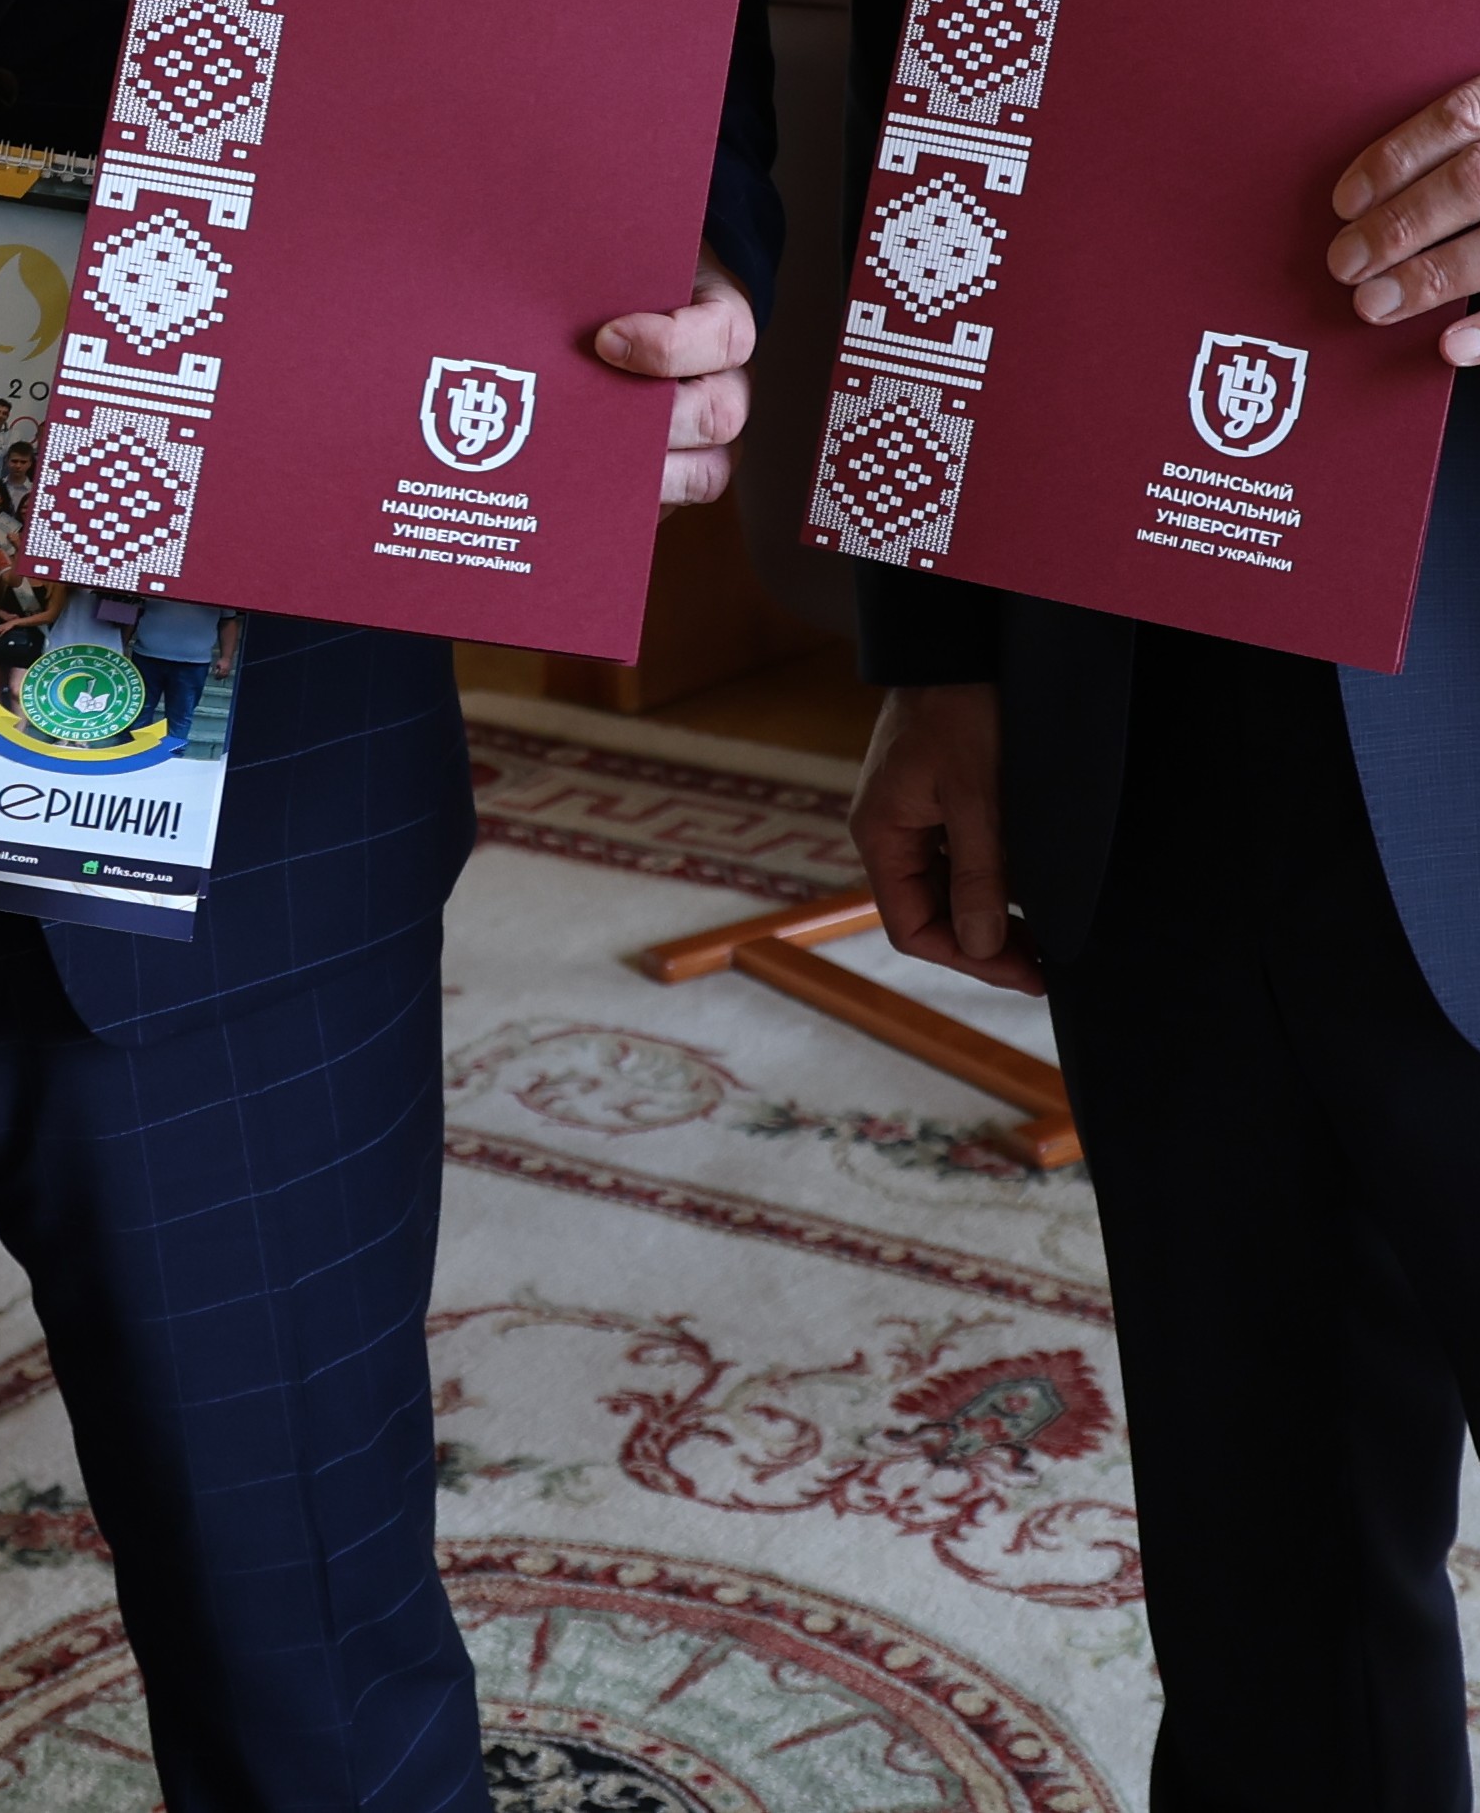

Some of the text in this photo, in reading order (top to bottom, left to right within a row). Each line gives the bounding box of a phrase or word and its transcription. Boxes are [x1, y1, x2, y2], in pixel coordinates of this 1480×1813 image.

[8, 378, 50, 402] 20
[397, 479, 529, 509] ВОЛИНСЬКИЙ
[1162, 462, 1294, 501] ВОЛИНСЬКИЙ
[381, 499, 537, 533] НАЦІОНАЛЬНИЙ
[1146, 483, 1301, 528] НАЦІОНАЛЬНИЙ
[392, 522, 520, 551] УНІВЕРСИТЕТ
[1155, 509, 1283, 547] УНІВЕРСИТЕТ
[374, 542, 531, 574] ІМЕНІ ЛЕСІ УКРАЇНКИ
[1136, 529, 1292, 572] ІМЕНІ ЛЕСІ УКРАЇНКИ
[23, 647, 141, 739] ХАРКІВСЬКИЙ ФАХОВИЙ КОЛЕДЖ СПОРТУ
[103, 864, 173, 883] hfks.org.ua
